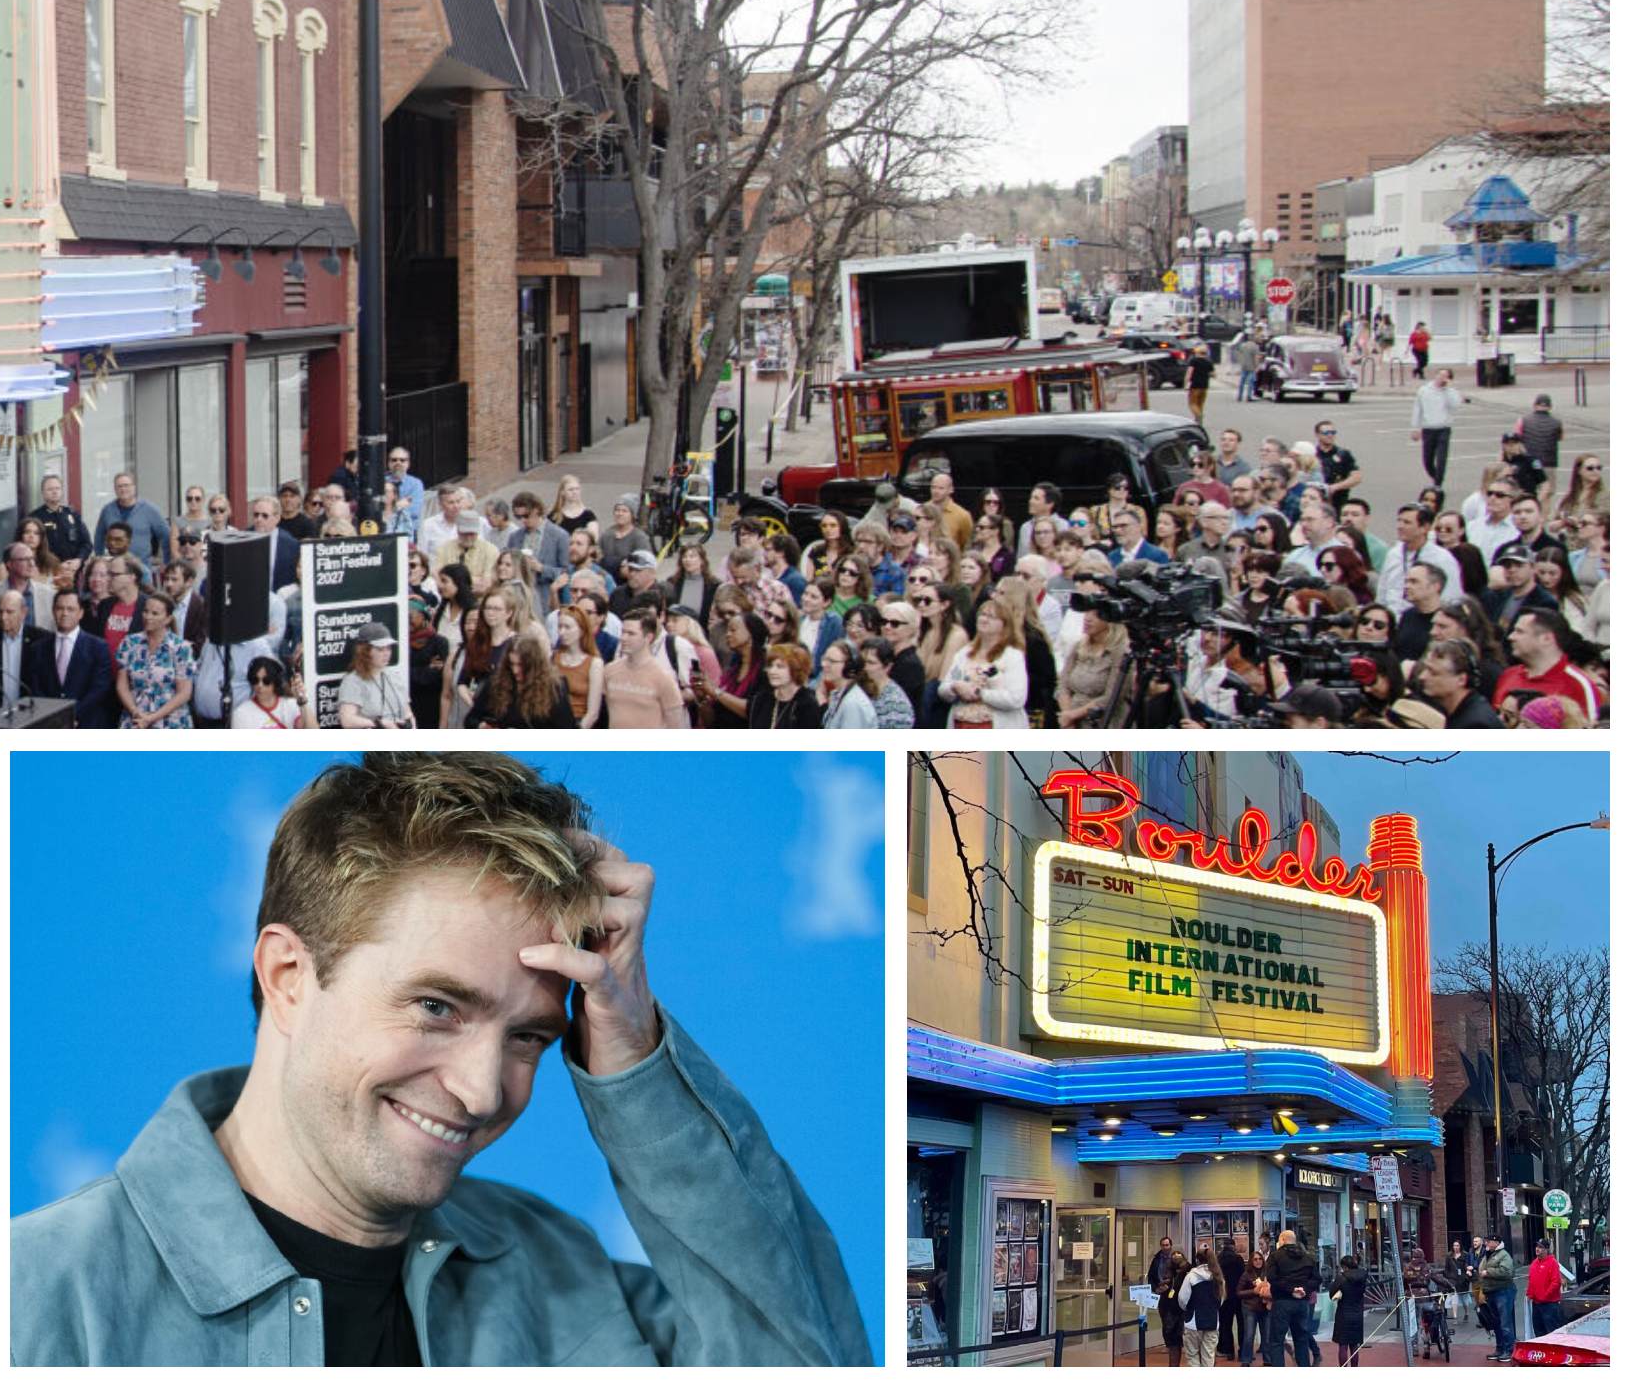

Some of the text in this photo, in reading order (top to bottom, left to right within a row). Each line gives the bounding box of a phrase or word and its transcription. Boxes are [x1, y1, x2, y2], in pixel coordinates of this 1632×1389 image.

[1268, 286, 1293, 297] STOP
[316, 542, 370, 556] Sundance
[316, 553, 382, 571] Film Festival
[316, 571, 345, 585] 2027
[318, 613, 372, 627] Sundance
[318, 629, 342, 642] Film
[318, 642, 345, 657] 2027
[1043, 770, 1382, 902] Boulder
[1170, 916, 1282, 954] BOULDER
[1126, 938, 1325, 988] INTERNATIONAL
[1128, 969, 1324, 1014] FILM FESTIVAL
